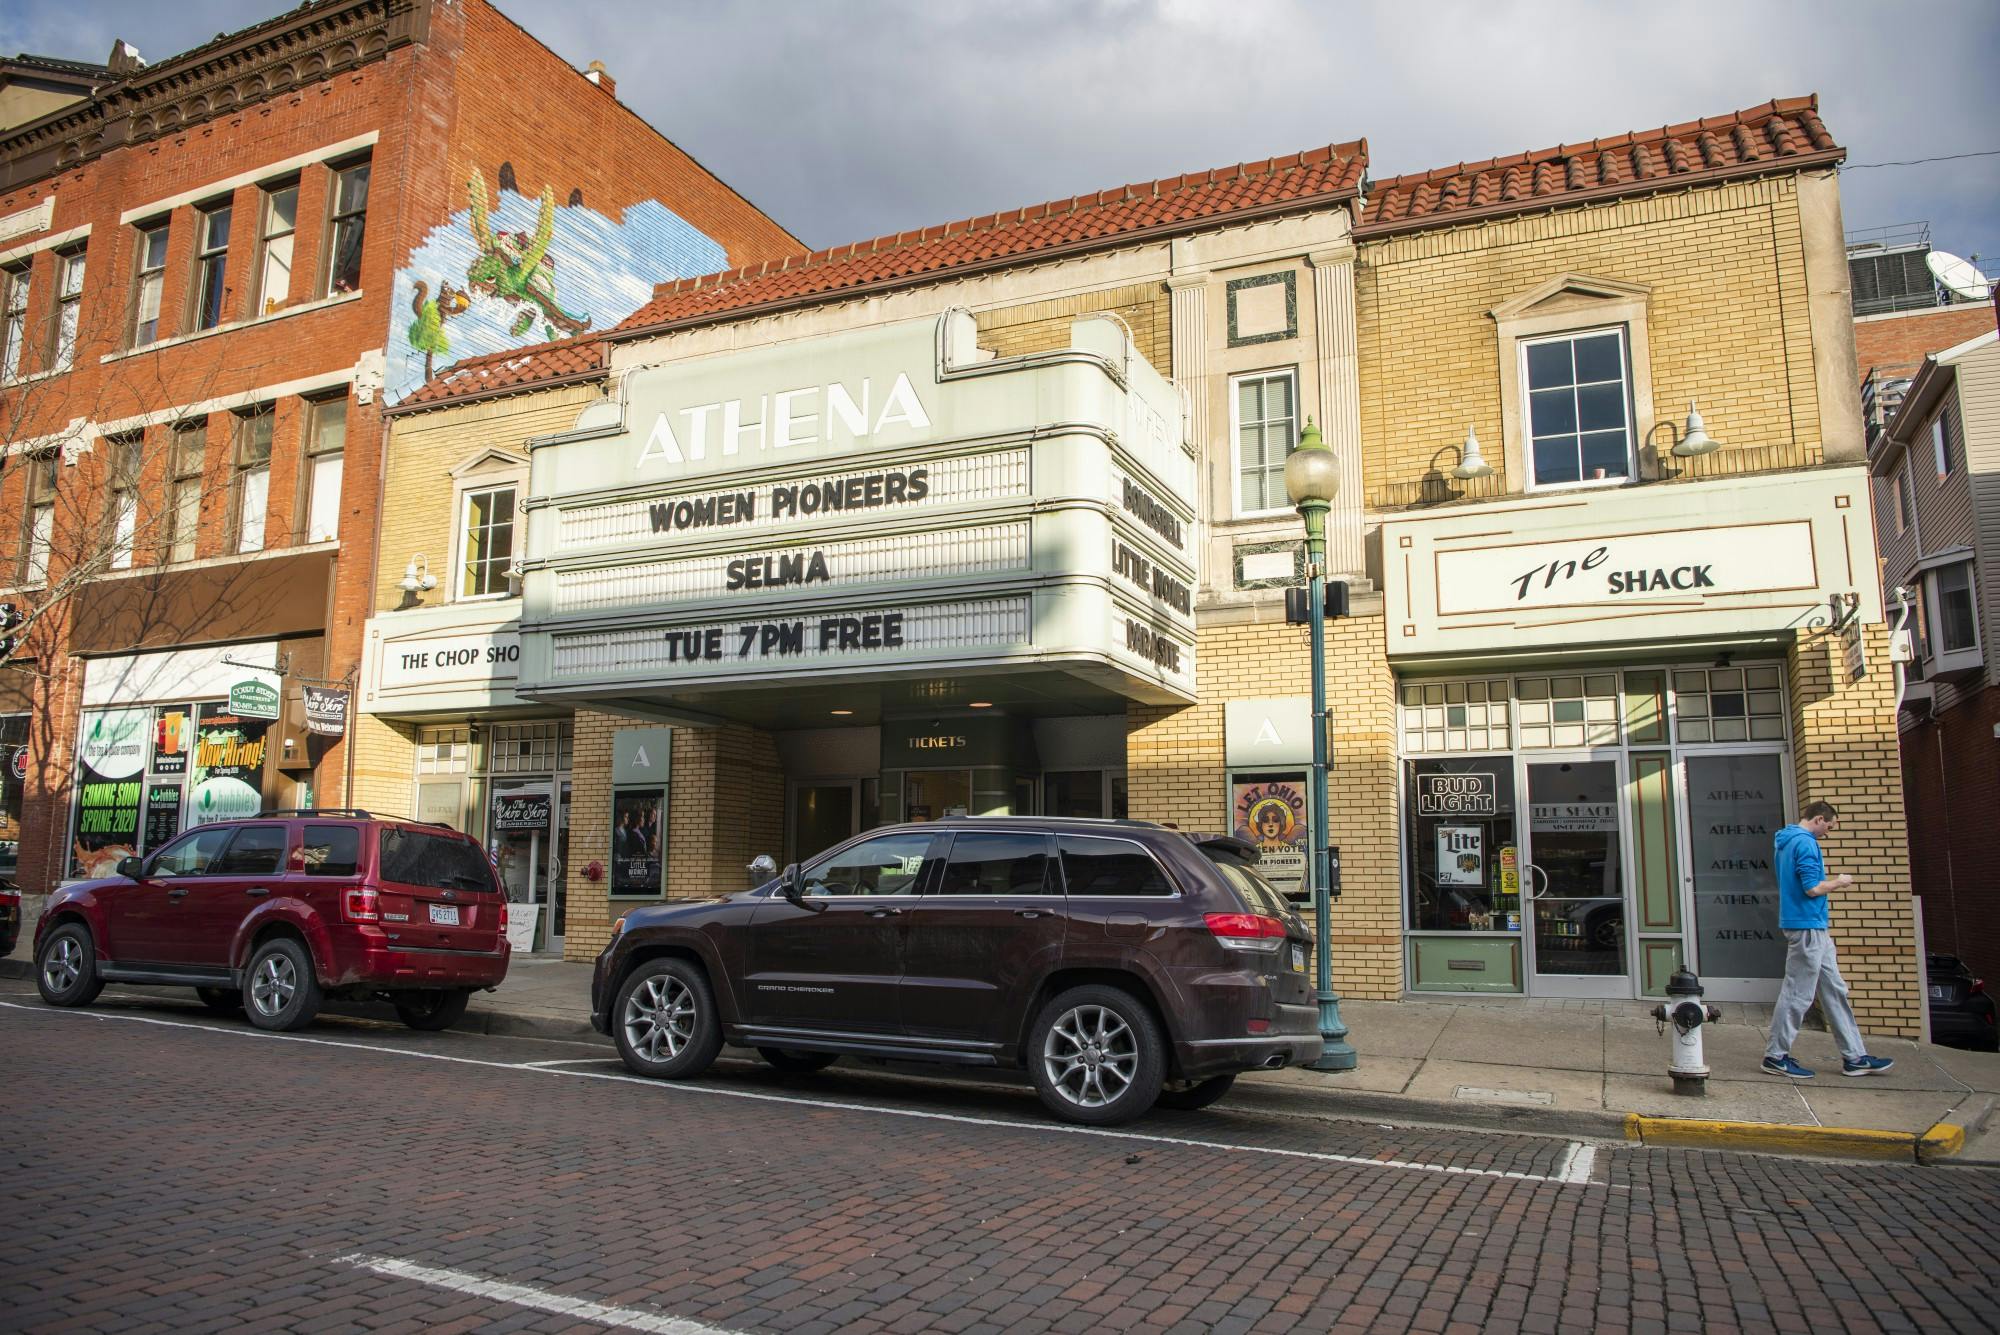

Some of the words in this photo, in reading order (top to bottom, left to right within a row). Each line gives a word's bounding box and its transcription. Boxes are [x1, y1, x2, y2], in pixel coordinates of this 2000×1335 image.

[634, 372, 932, 470] ATHENA
[649, 491, 755, 533] WOMEN
[771, 469, 929, 519] PIONEERS
[1122, 475, 1183, 551] BOMBSHELL
[726, 551, 830, 590] SELMA
[1112, 538, 1150, 592] LITTLE
[1152, 565, 1191, 617] WOMEN
[1510, 545, 1610, 600] The
[1607, 564, 1715, 595] SHACK
[664, 628, 723, 663] TUE
[738, 621, 804, 658] 7PM
[819, 613, 904, 651] FREE
[1126, 617, 1181, 674] PARASITE
[401, 652, 429, 670] THE
[435, 648, 480, 668] CHOP
[908, 735, 966, 750] TICKETS
[1253, 717, 1284, 745] A
[197, 737, 223, 768] Now
[223, 735, 266, 770] Hiring!
[631, 744, 651, 767] A
[82, 783, 117, 807] COMING
[116, 782, 141, 806] SOON
[1237, 786, 1262, 813] LET
[1268, 783, 1304, 810] OHIO
[1432, 777, 1482, 795] BUD
[1706, 789, 1764, 800] ATHENA
[217, 788, 256, 813] bubbles
[80, 809, 113, 832] SPRING
[112, 809, 137, 832] 2020
[1709, 824, 1767, 835] ATHENA
[1278, 845, 1304, 853] VOTE
[1446, 833, 1480, 854] Lite
[1711, 859, 1769, 870] ATHENA
[1713, 894, 1773, 905] ATHENA
[1715, 929, 1774, 940] ATHENA
